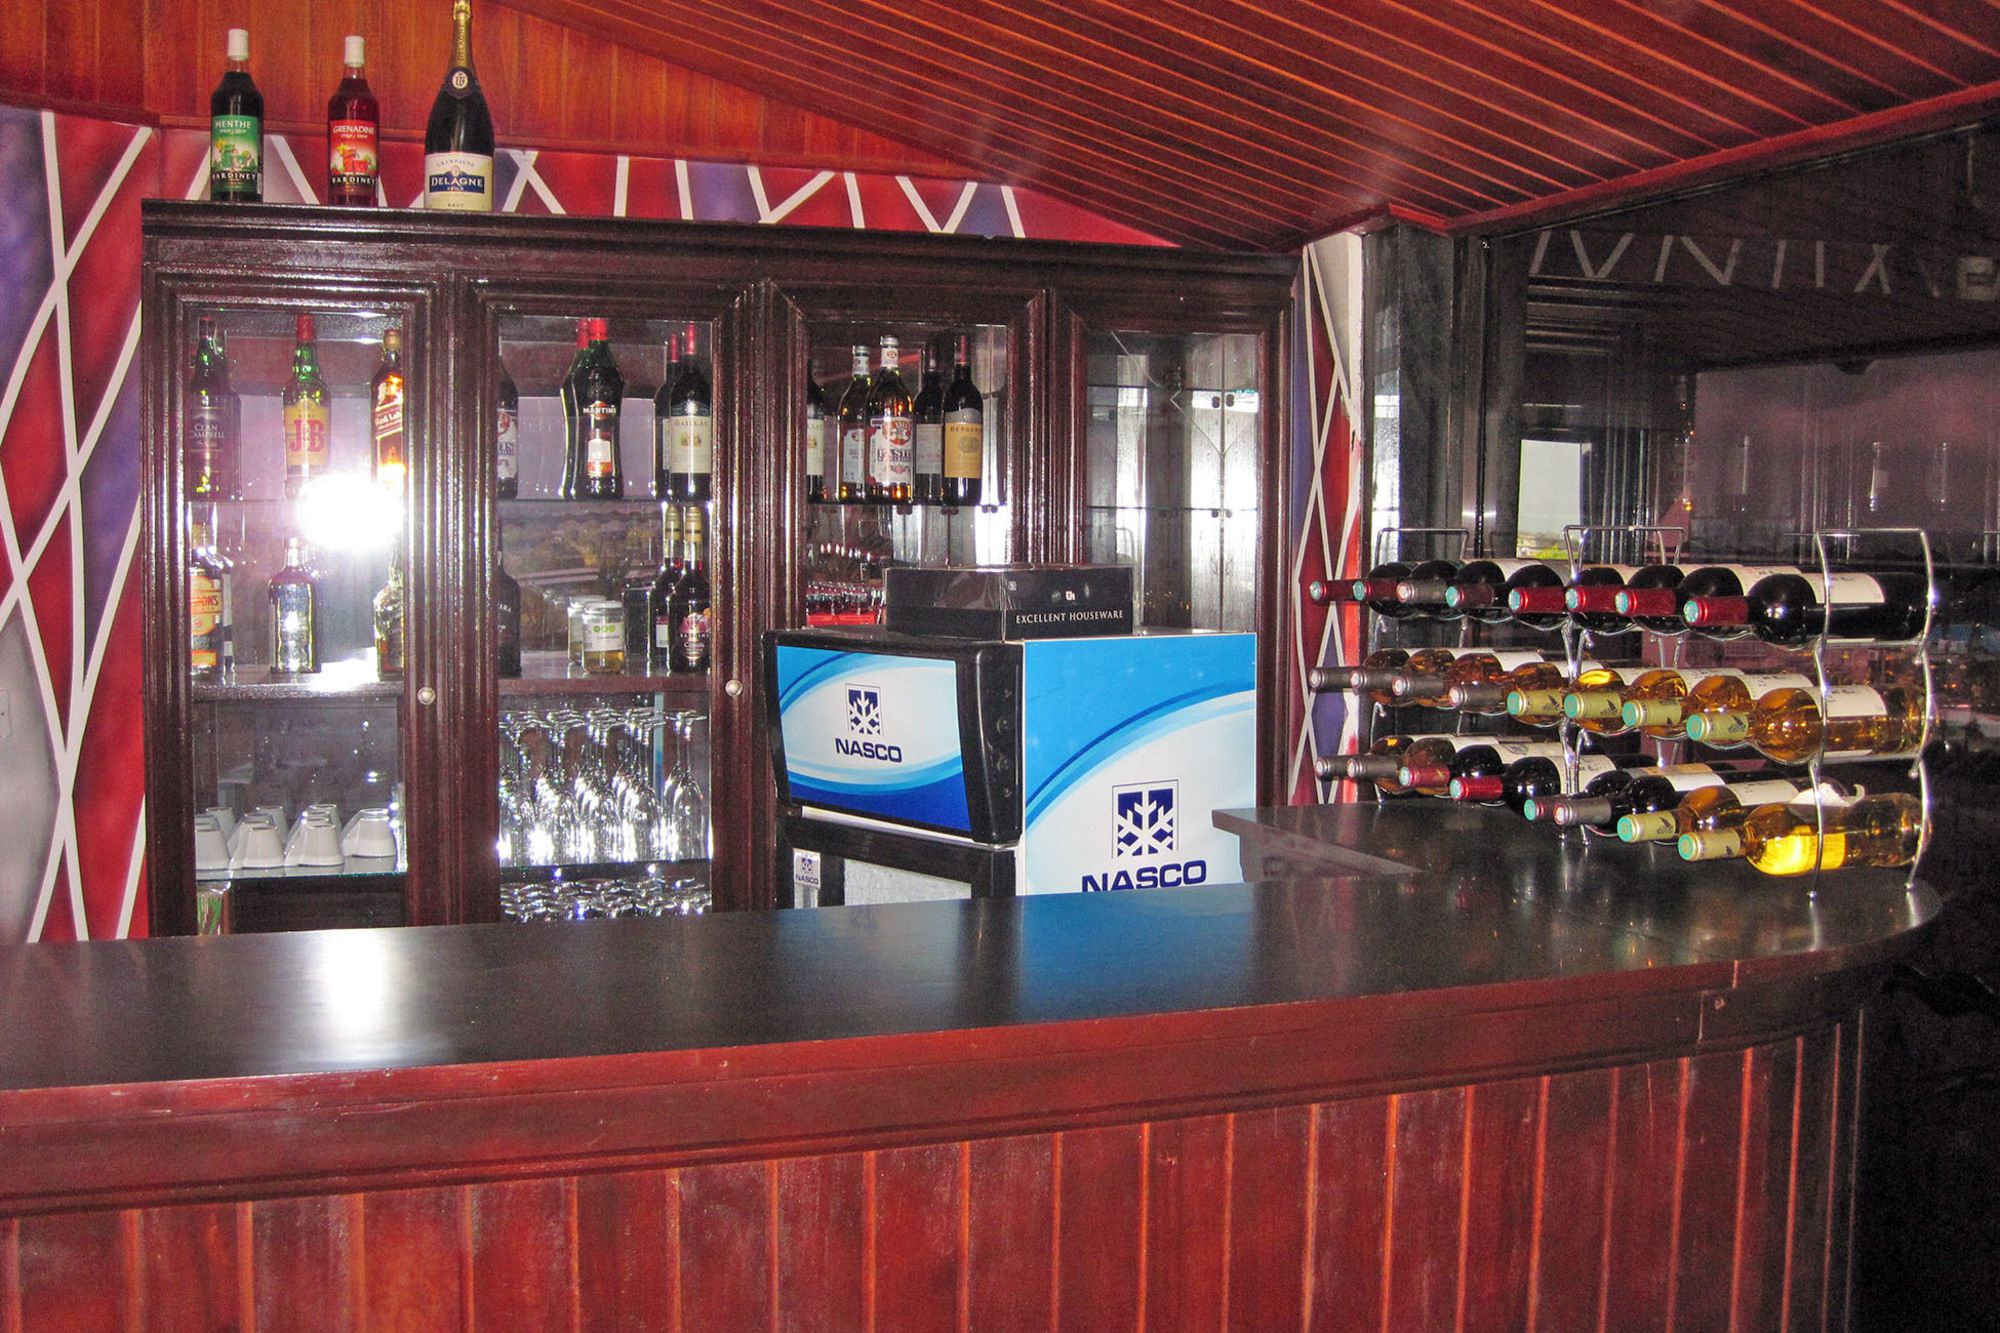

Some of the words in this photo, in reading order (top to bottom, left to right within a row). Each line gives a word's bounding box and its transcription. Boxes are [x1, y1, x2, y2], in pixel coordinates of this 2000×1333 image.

[333, 125, 374, 135] GRENADINE
[431, 177, 483, 187] DELAGNE
[194, 423, 218, 432] CLAN
[1016, 613, 1067, 624] EXCELLENT
[1069, 610, 1124, 622] HOUSEWARE
[835, 738, 902, 763] NASCO
[795, 874, 819, 885] NASCO
[1081, 859, 1207, 893] NASCO
